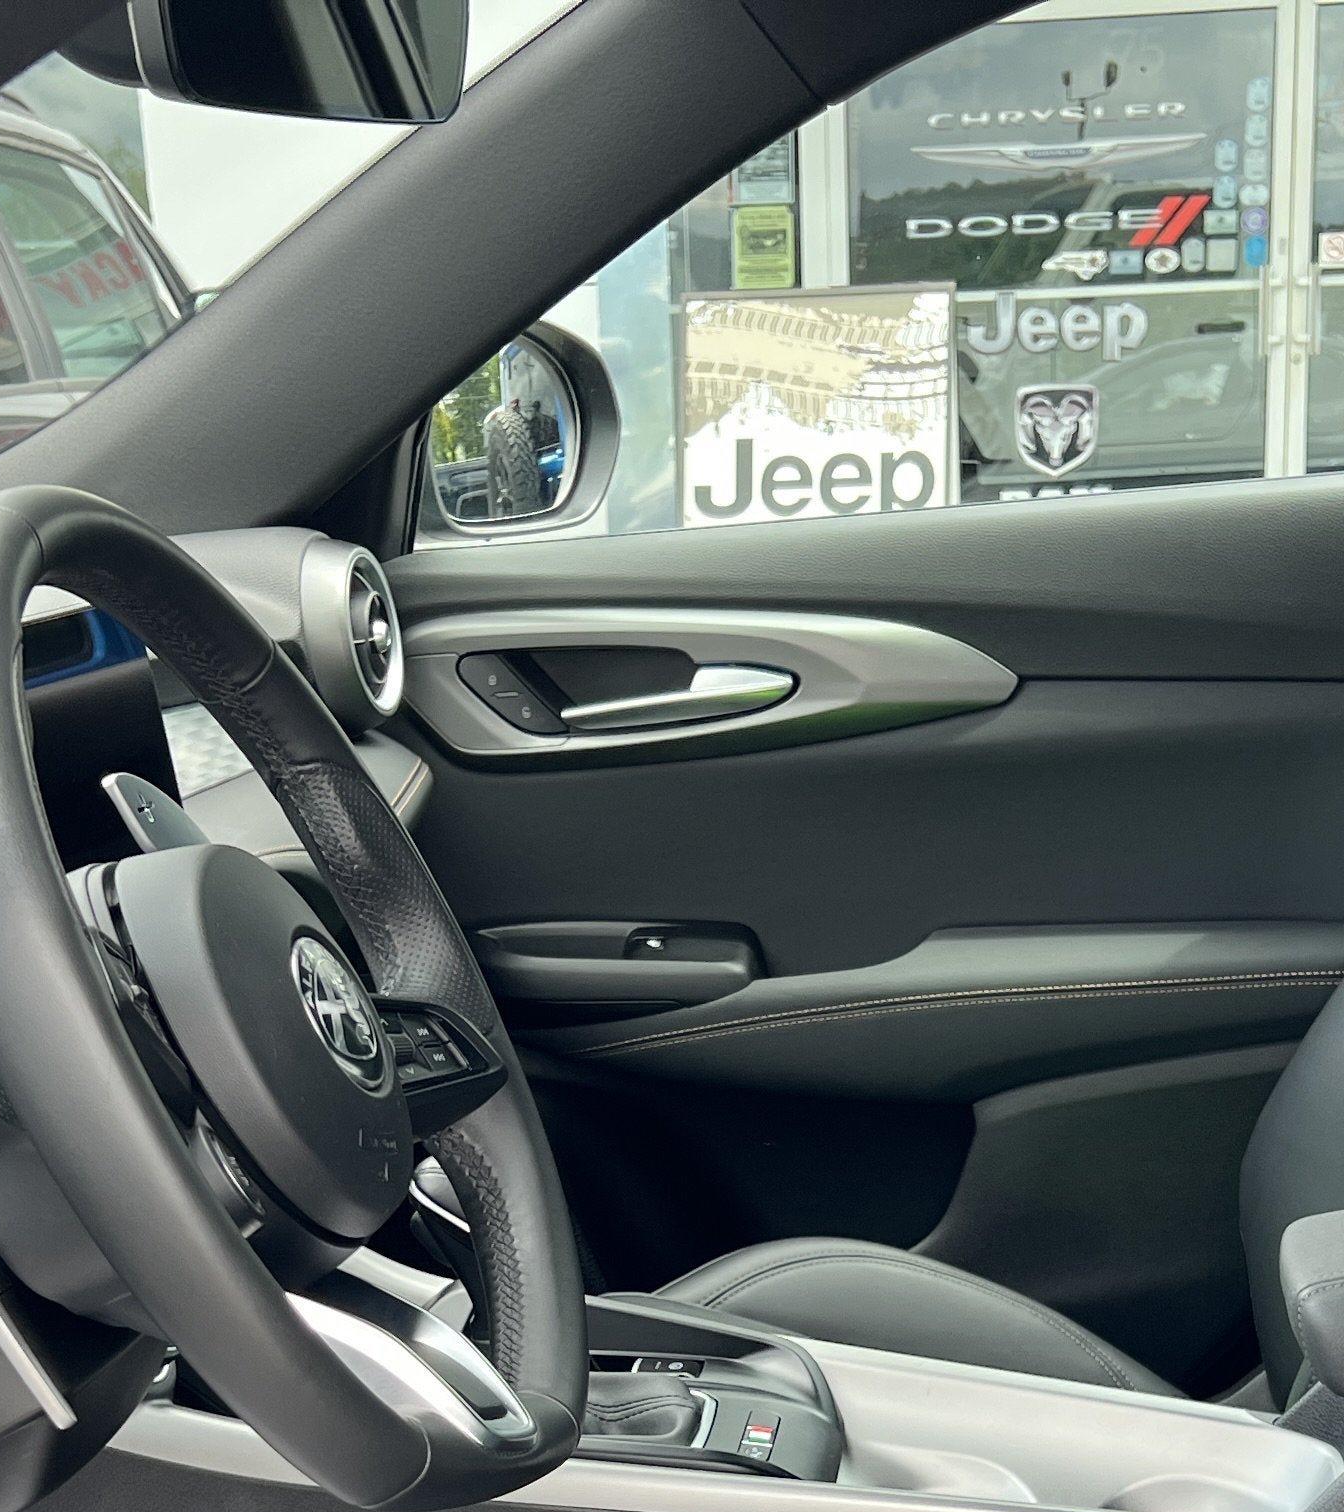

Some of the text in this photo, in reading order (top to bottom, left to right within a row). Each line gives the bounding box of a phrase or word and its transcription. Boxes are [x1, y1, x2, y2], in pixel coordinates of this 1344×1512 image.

[927, 101, 1186, 129] CHRYSLER
[905, 208, 1164, 239] DODGE
[966, 292, 1149, 362] Jeep
[693, 438, 935, 519] Jeep
